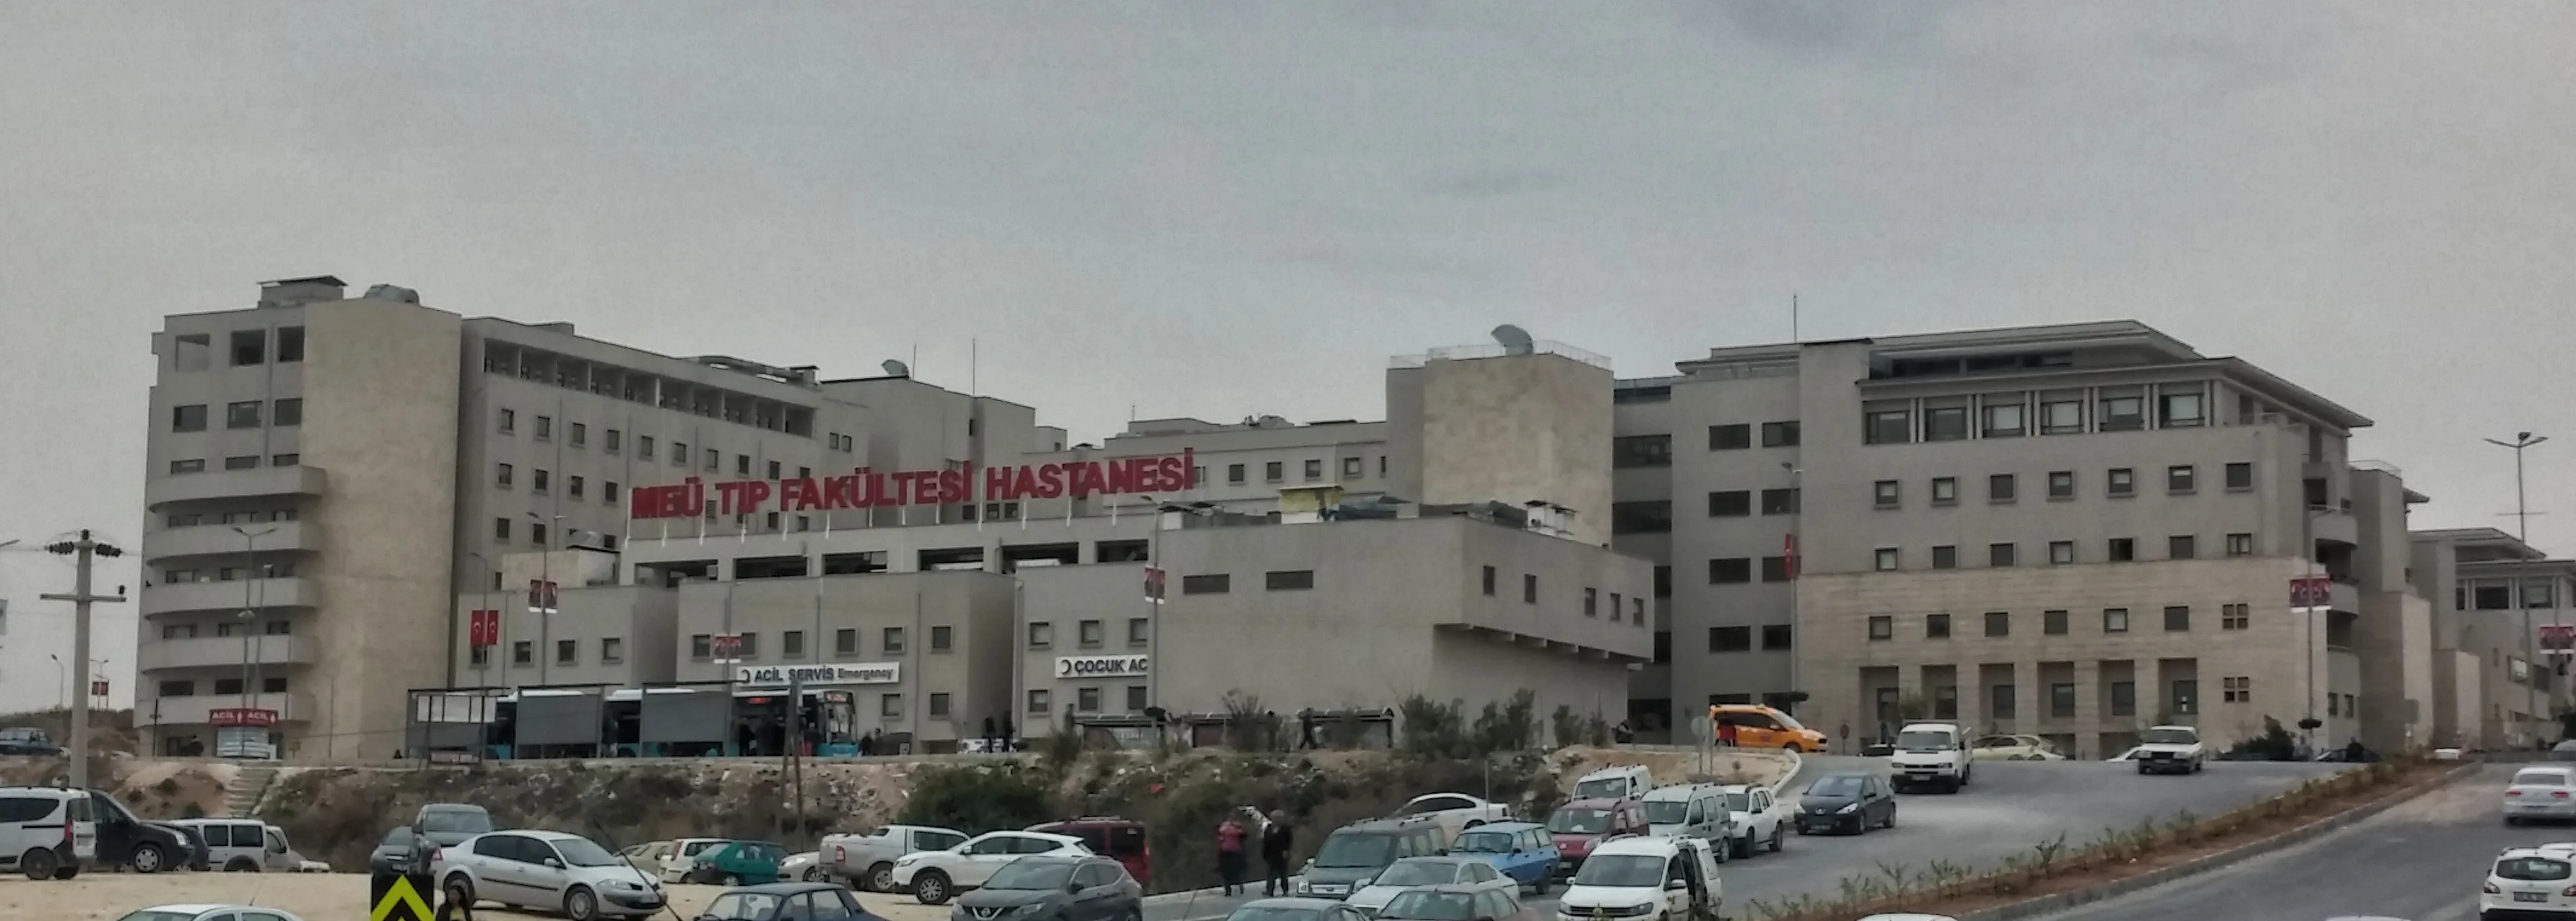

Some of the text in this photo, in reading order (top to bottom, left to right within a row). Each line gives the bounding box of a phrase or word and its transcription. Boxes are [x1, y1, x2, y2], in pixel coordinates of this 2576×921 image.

[715, 481, 770, 515] TIP
[781, 461, 973, 512] FAKÜLTESİ
[986, 447, 1193, 501] HASTANESİ
[755, 665, 895, 681] ACİL SERVİS Emergency
[1074, 659, 1126, 676] ÇOCUK
